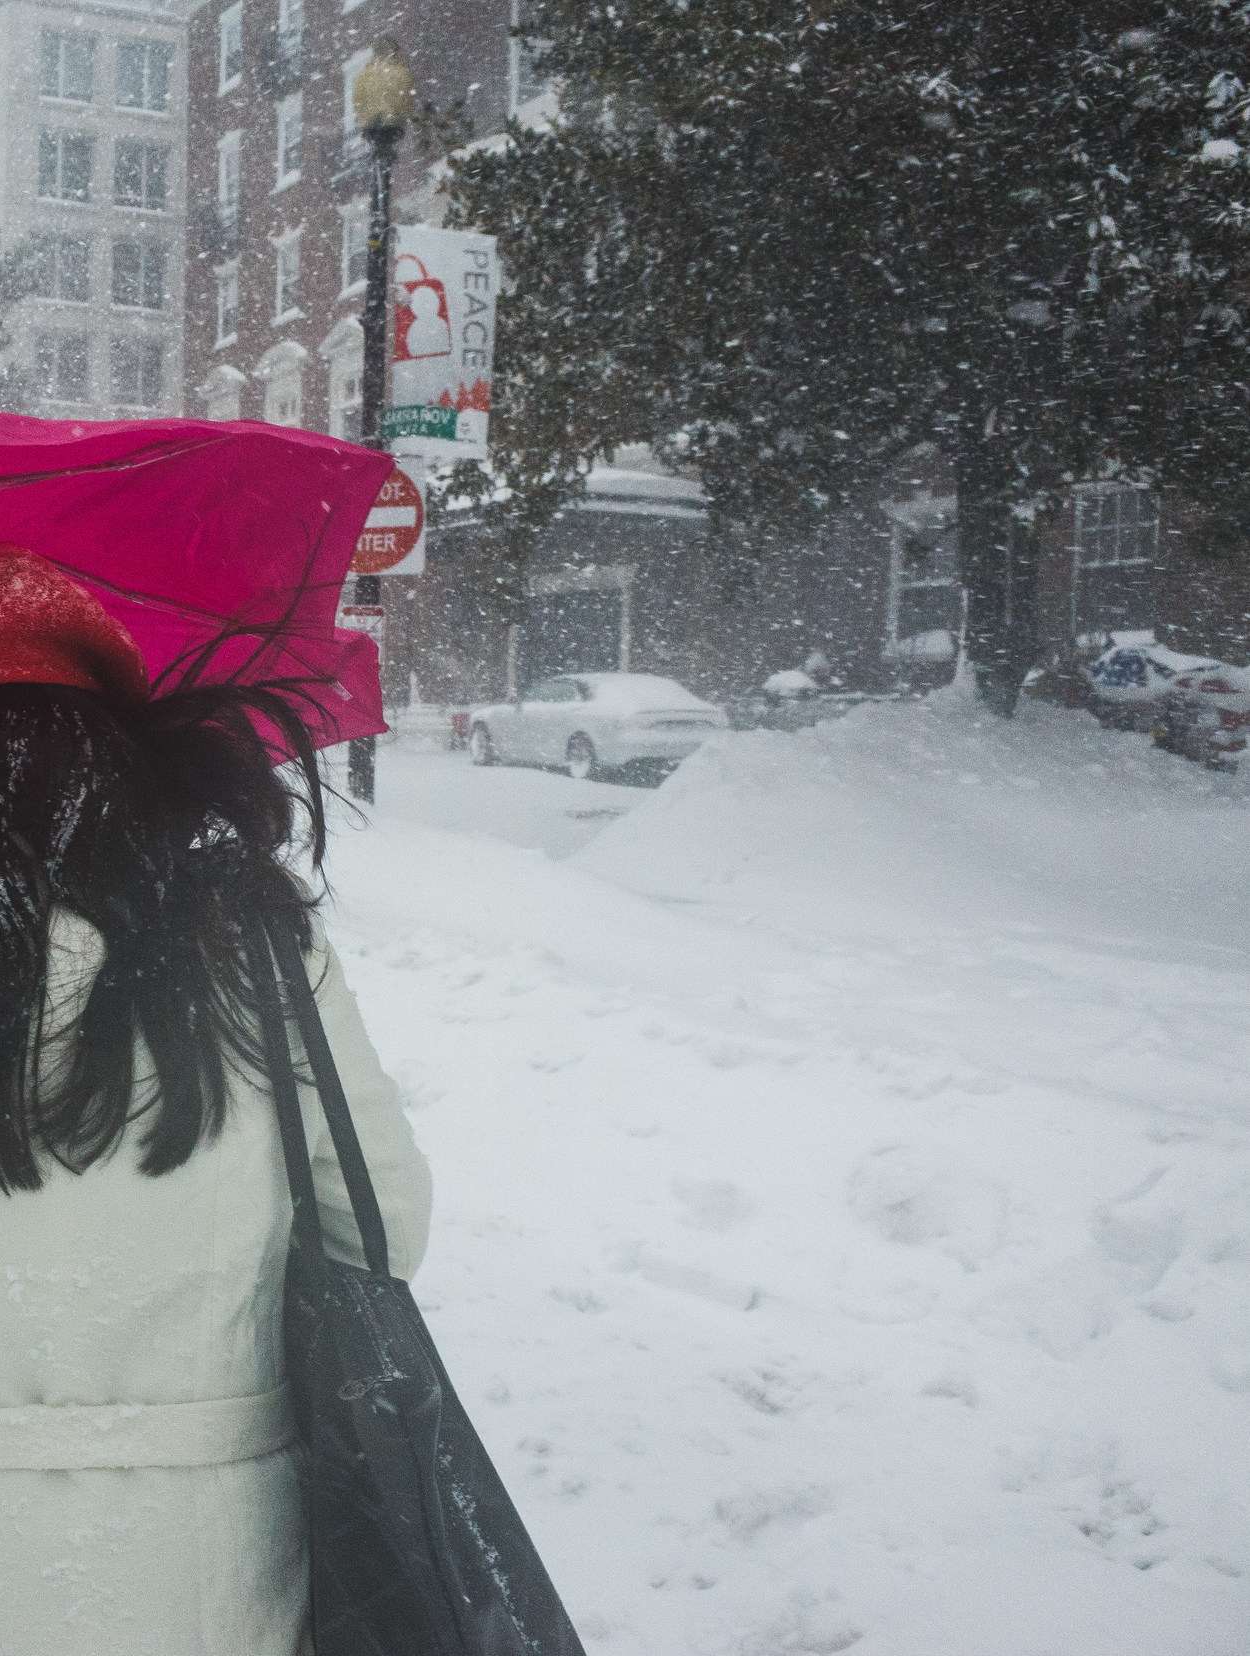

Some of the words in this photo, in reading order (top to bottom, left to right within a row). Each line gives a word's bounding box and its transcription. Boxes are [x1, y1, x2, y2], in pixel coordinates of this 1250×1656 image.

[462, 249, 489, 367] PEACE
[378, 482, 404, 501] OT
[357, 533, 396, 552] TER
